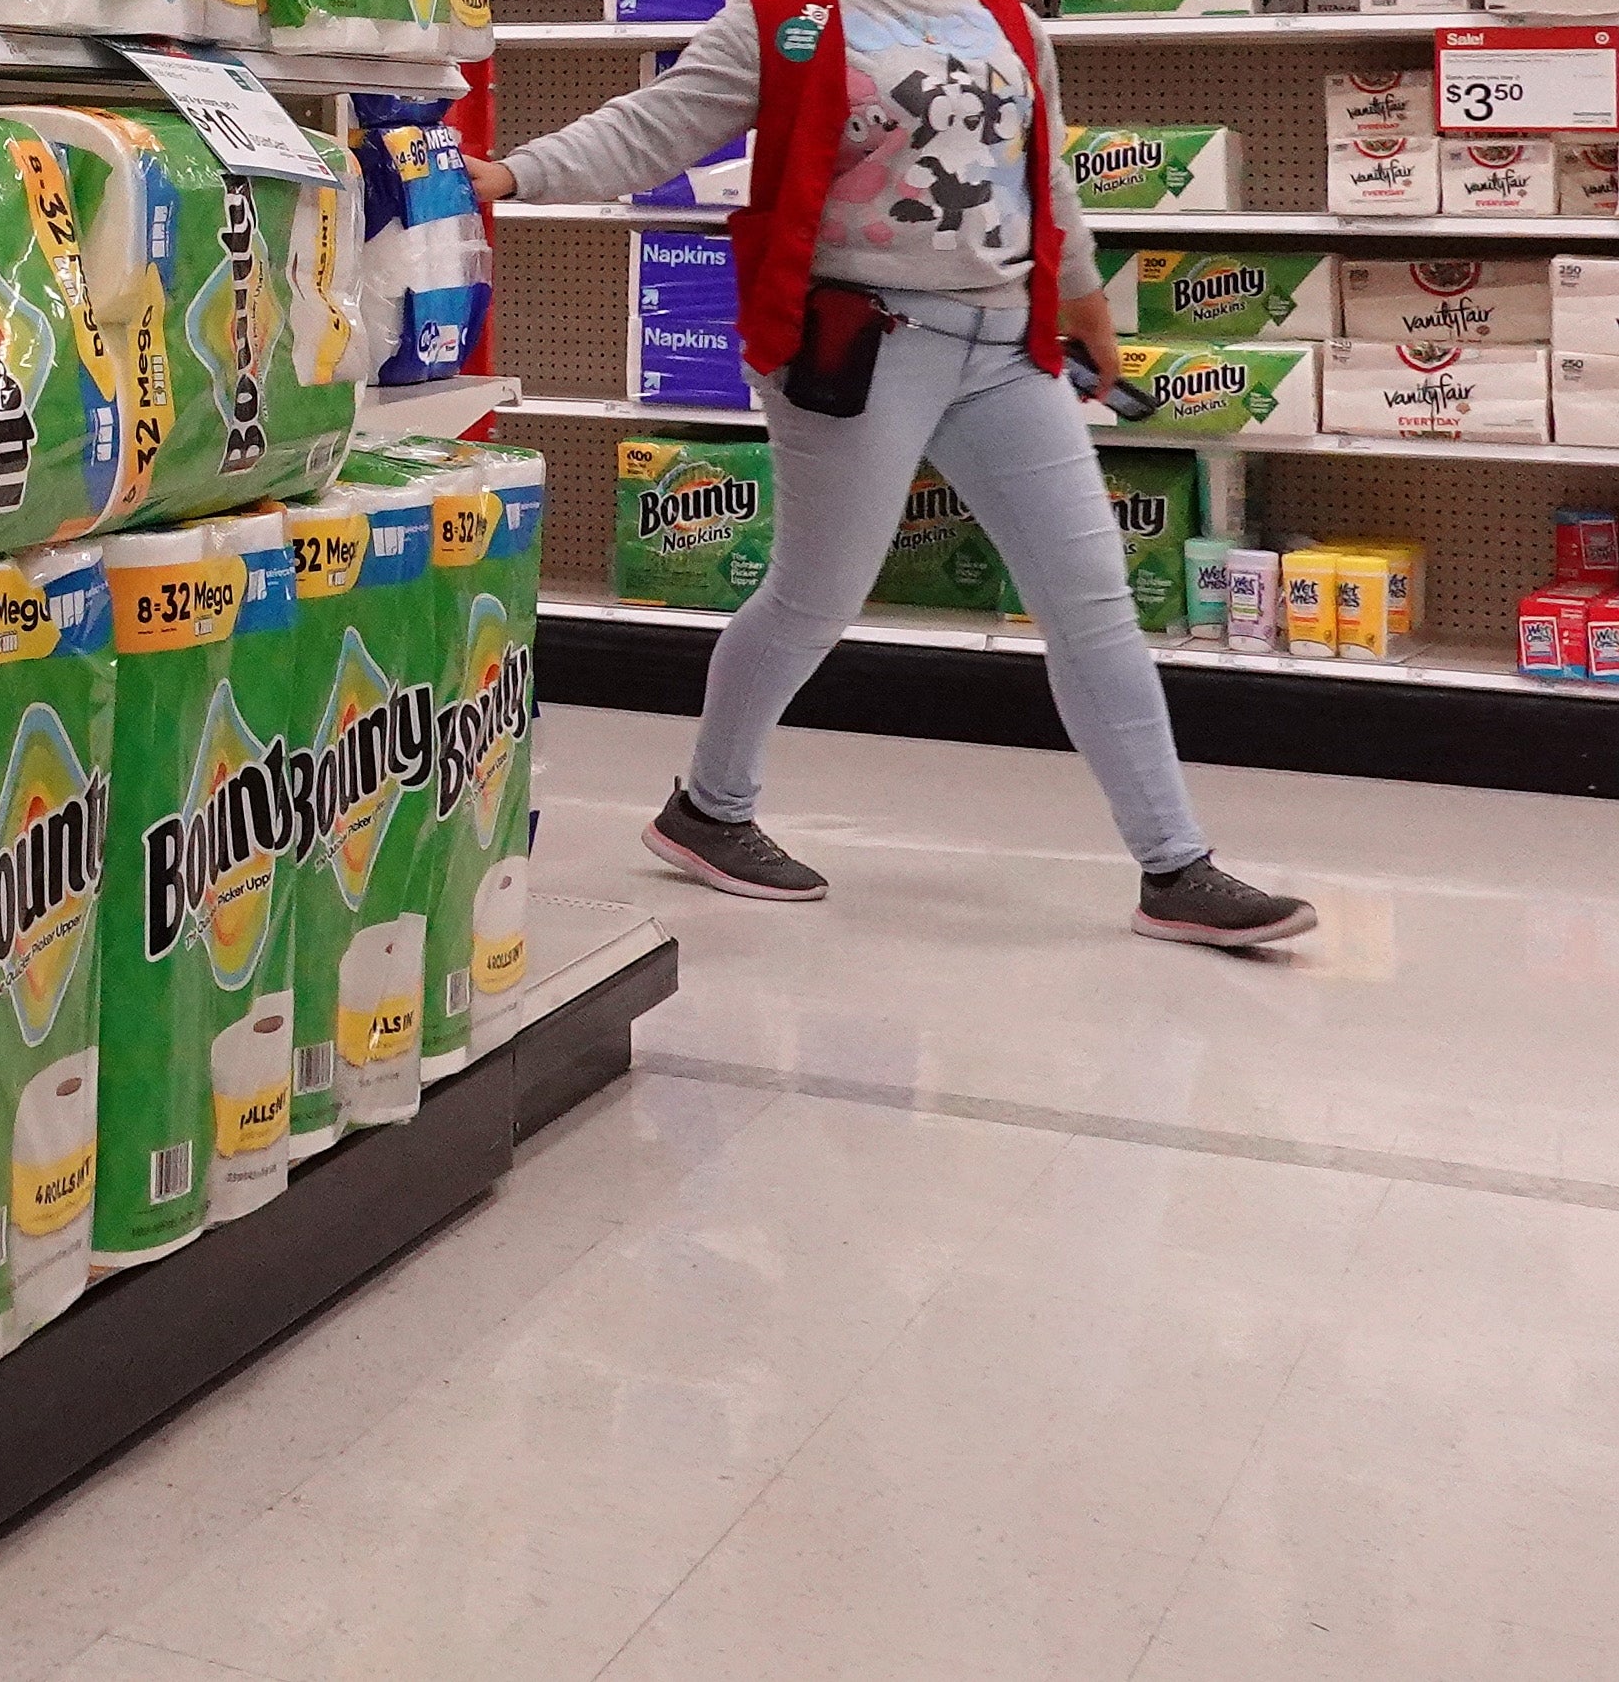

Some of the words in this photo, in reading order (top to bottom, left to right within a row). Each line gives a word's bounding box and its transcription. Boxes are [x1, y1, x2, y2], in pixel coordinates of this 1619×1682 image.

[1446, 32, 1486, 48] Sale!
[1074, 139, 1164, 185] Bounty
[1092, 173, 1147, 195] Napkins
[642, 246, 727, 267] Napkins
[1143, 257, 1167, 269] 200
[1172, 264, 1265, 313] Bounty
[1192, 299, 1248, 322] Napkins
[644, 327, 729, 351] Napkins
[137, 304, 156, 409] Mega
[1122, 351, 1147, 363] 200
[1561, 358, 1585, 368] 250
[1153, 363, 1247, 408] Bounty
[1173, 397, 1228, 419] Napkins
[1398, 417, 1462, 428] EVERYDAY
[638, 476, 758, 539] Bounty
[662, 523, 732, 555] Napkins
[193, 581, 234, 615] Mega
[438, 643, 529, 820] Bounty
[291, 682, 432, 863] Bounty
